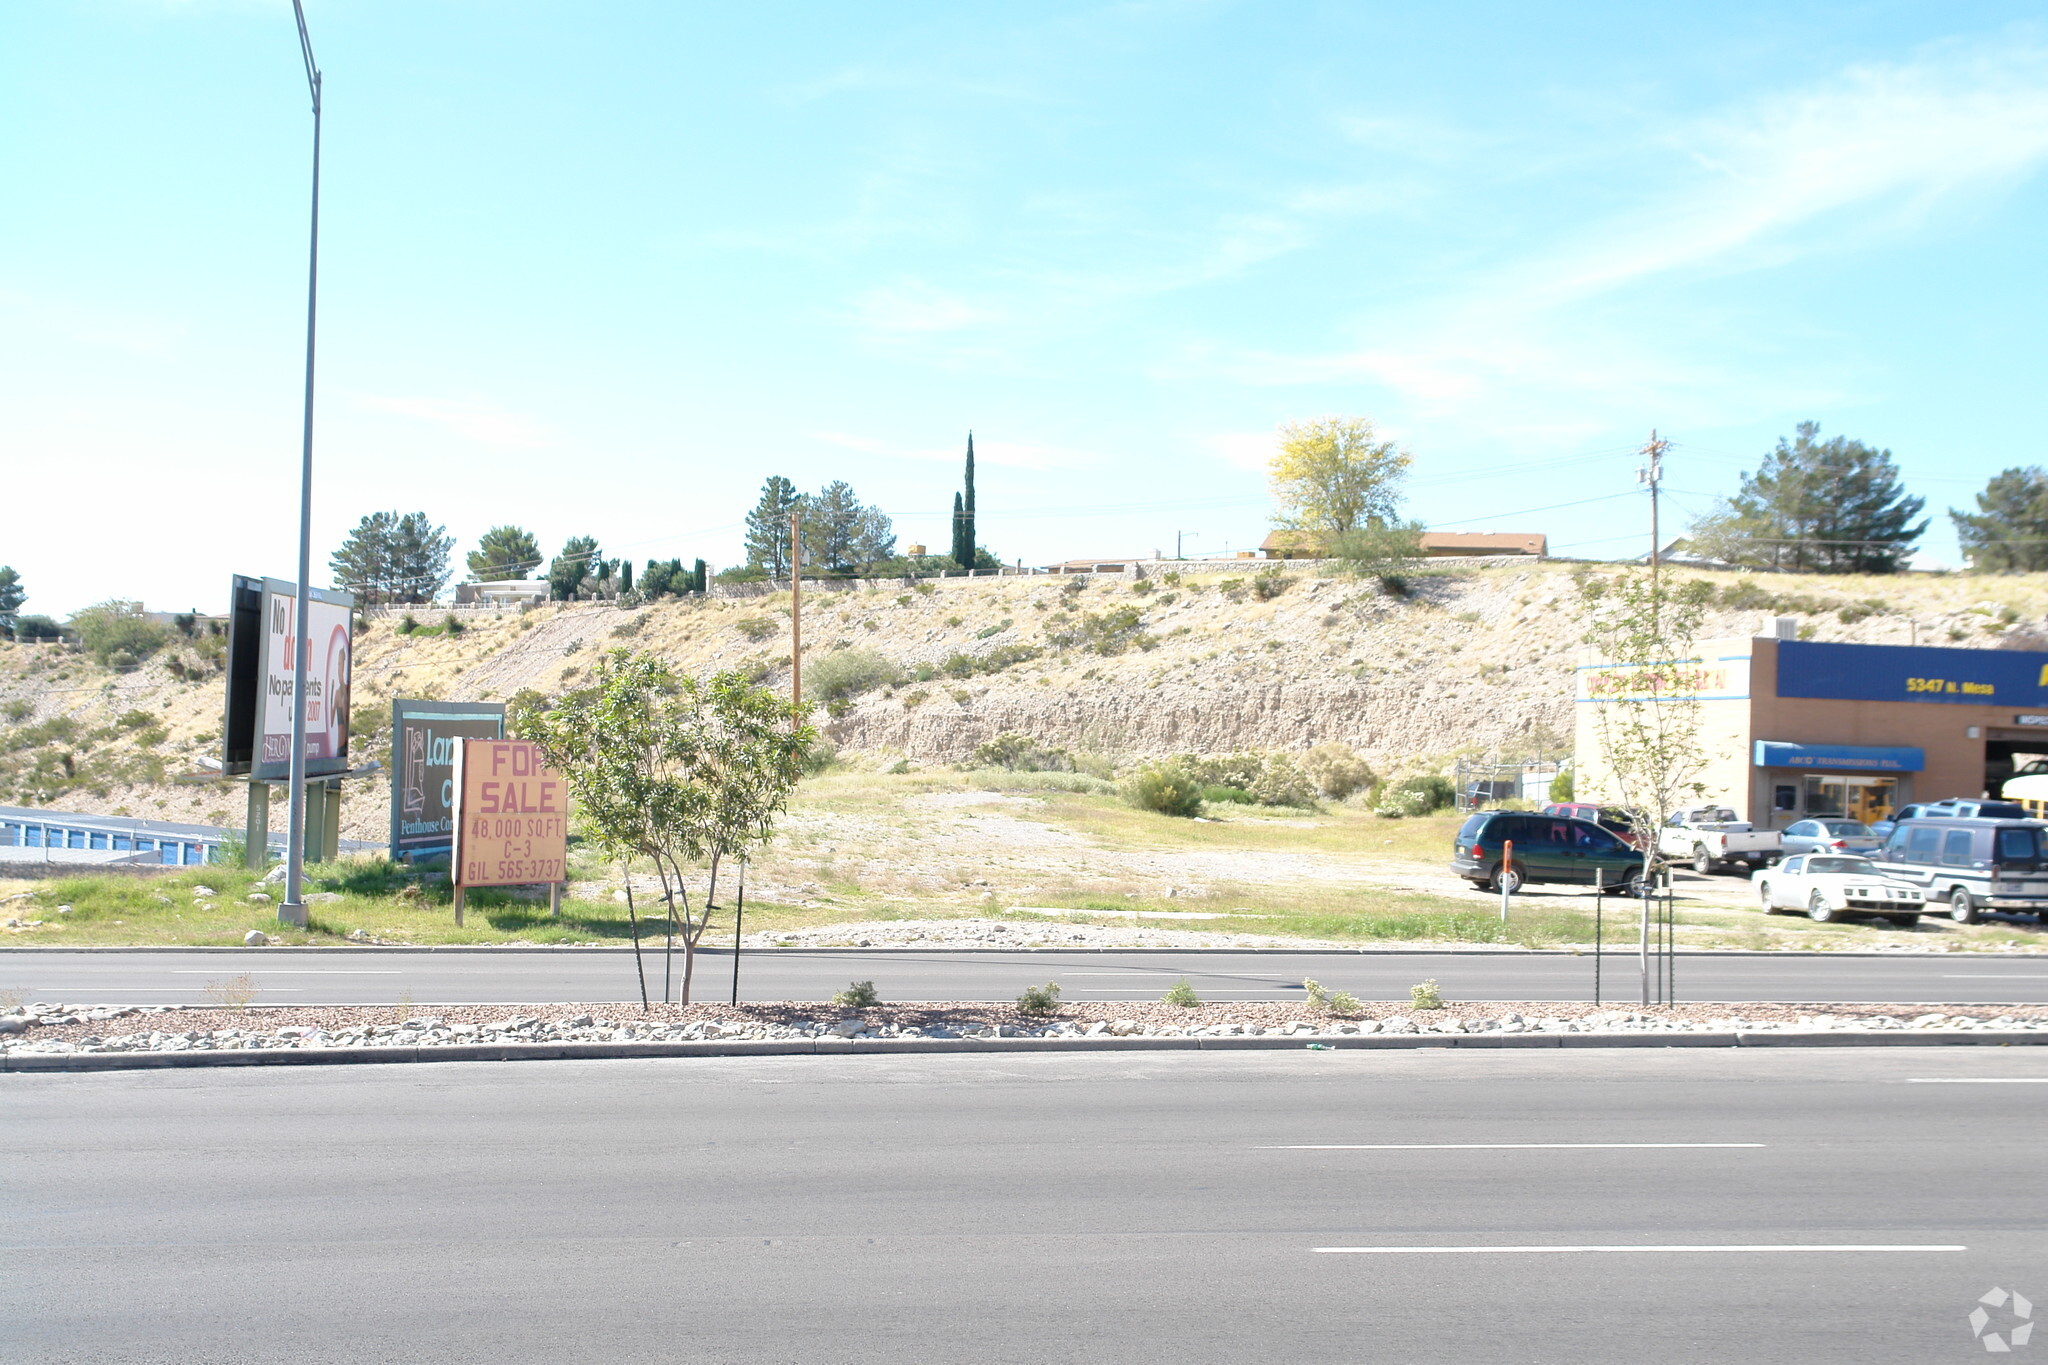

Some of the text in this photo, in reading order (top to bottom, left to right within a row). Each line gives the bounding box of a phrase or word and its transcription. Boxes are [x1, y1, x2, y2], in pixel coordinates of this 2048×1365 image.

[272, 598, 286, 635] No
[268, 674, 322, 707] No paents
[1906, 677, 1945, 693] 5347
[1961, 682, 1995, 695] Mesa
[307, 701, 321, 722] 2007
[492, 744, 549, 777] FOR
[480, 782, 557, 814] SALE
[401, 818, 440, 836] Penthouse
[504, 839, 532, 859] C-3
[468, 859, 561, 881] GIL 565-3737
